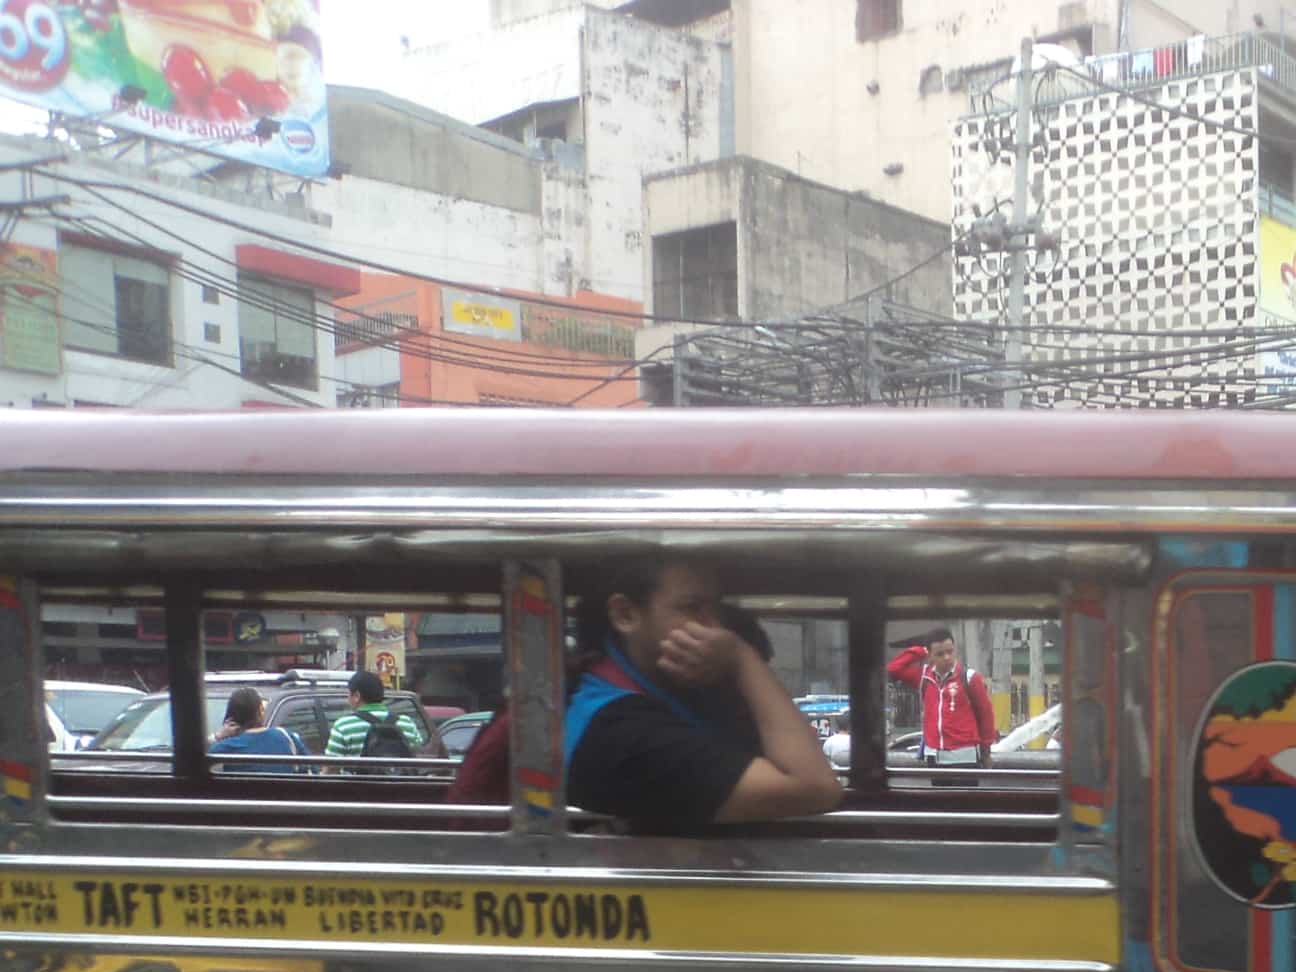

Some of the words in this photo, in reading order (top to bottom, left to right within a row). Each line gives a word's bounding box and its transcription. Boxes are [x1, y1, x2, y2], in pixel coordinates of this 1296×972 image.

[73, 881, 166, 929] TAFT
[319, 911, 444, 936] LIBERTAD
[473, 891, 652, 942] ROTONDA
